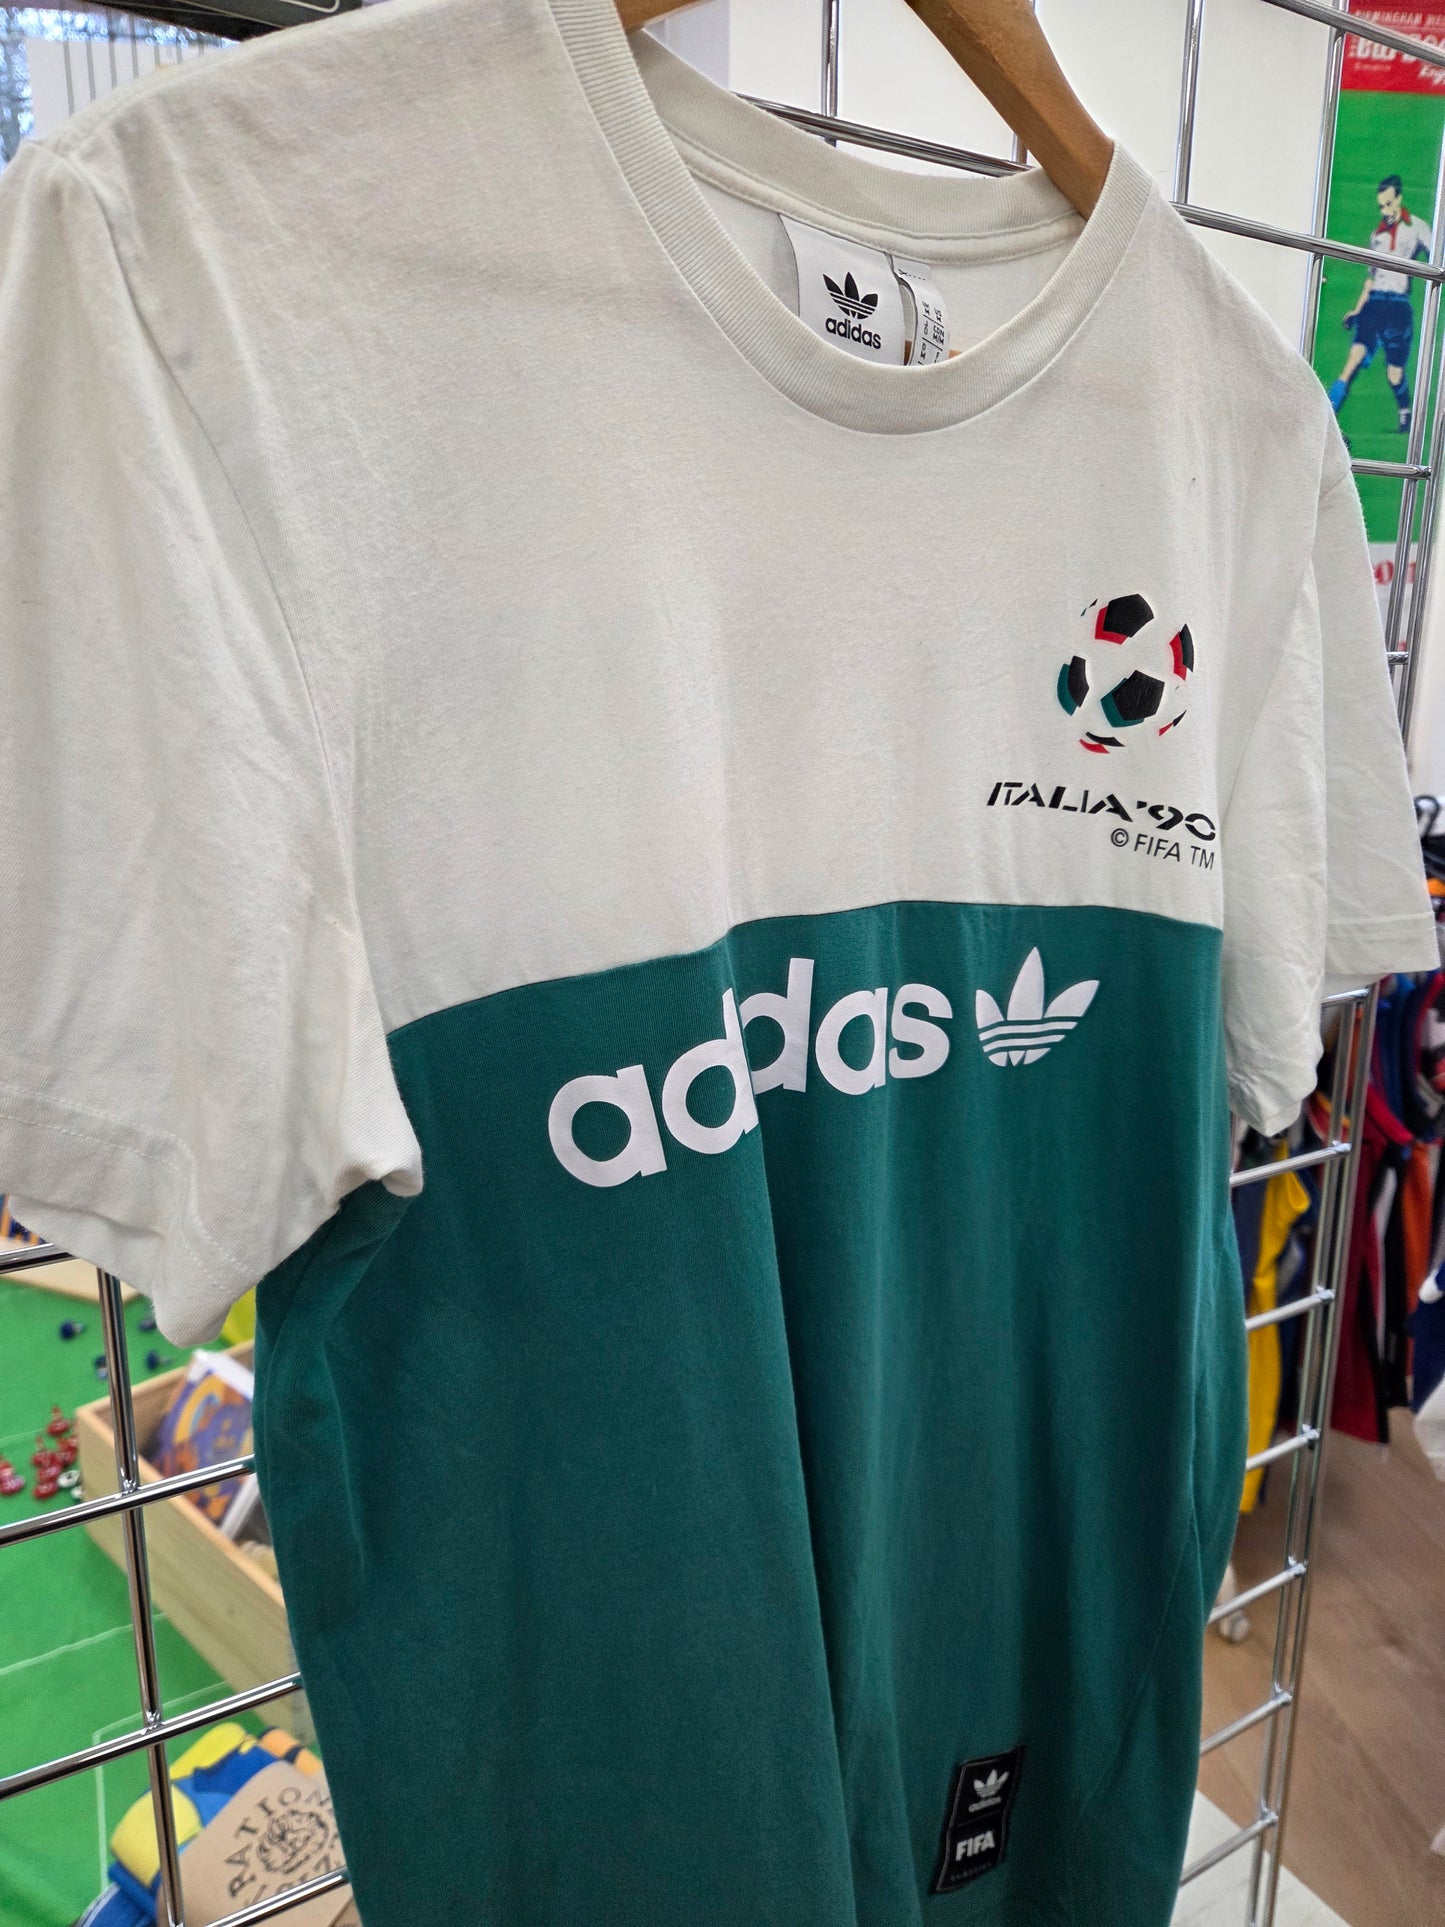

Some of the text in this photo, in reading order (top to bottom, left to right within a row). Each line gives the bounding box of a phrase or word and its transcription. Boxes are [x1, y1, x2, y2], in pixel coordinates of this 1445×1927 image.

[825, 318, 881, 349] adidas
[1133, 833, 1181, 863] FIFA
[1190, 845, 1216, 871] TM
[548, 956, 953, 1188] addas
[955, 1830, 995, 1861] FIFA
